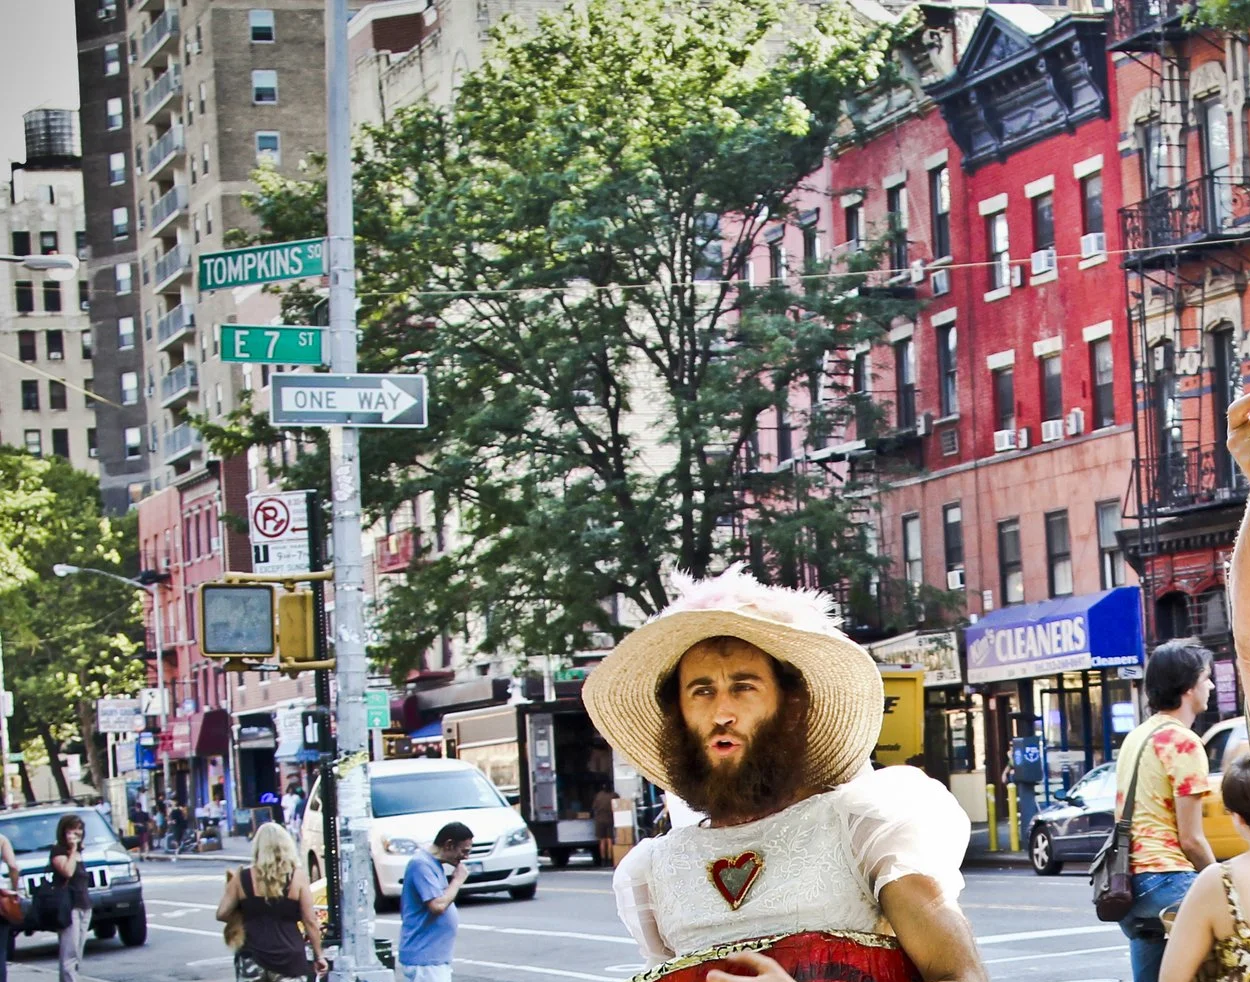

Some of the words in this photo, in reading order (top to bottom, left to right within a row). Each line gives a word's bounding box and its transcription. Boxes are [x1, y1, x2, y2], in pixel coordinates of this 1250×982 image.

[203, 246, 303, 286] TOMPKINS
[307, 244, 322, 260] SQ
[234, 330, 250, 358] E
[263, 330, 281, 359] 7
[298, 332, 315, 346] ST
[294, 390, 337, 409] ONE
[358, 391, 402, 410] WAY
[995, 616, 1086, 662] CLEANERS
[1092, 655, 1139, 667] Cleaners
